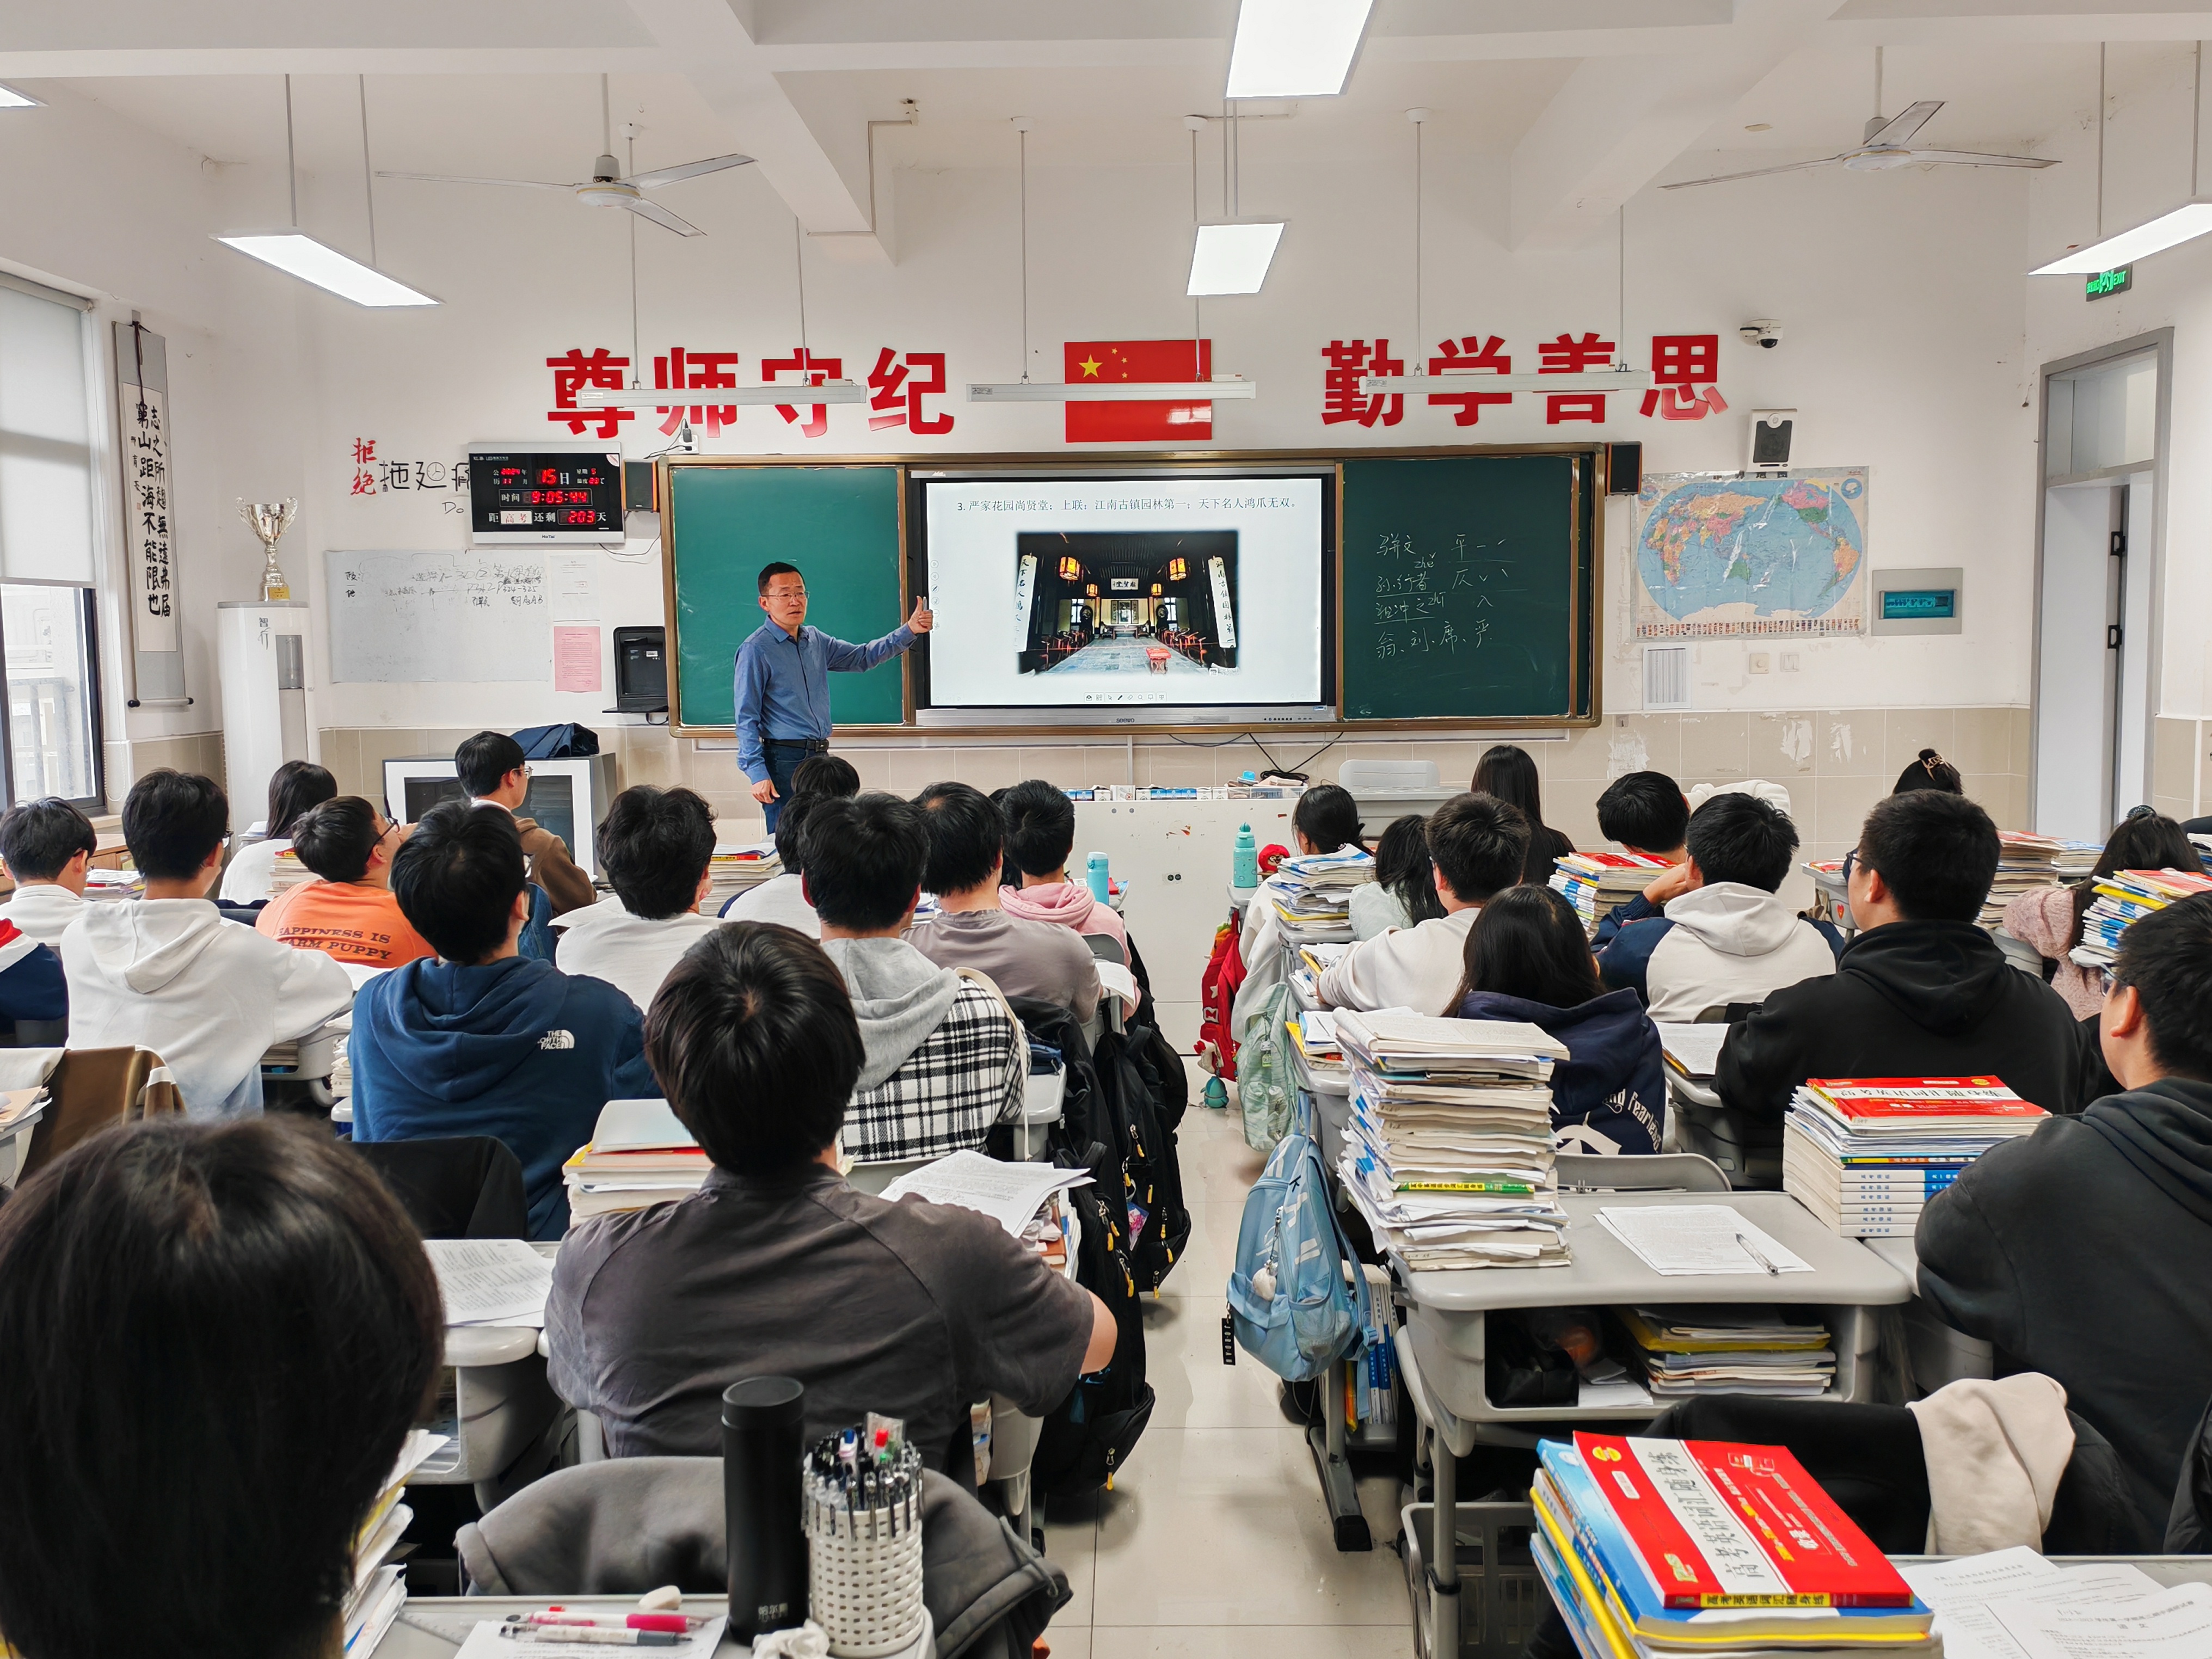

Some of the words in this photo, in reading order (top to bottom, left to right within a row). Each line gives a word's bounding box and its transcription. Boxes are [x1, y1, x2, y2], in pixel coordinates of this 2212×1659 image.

[2113, 271, 2126, 285] EXIT
[1322, 333, 1728, 428] 勤学善思
[546, 347, 954, 439] 尊师守纪
[351, 437, 377, 495] 拒绝
[542, 469, 556, 485] 15
[560, 472, 569, 484] 日
[501, 493, 520, 502] 时间
[531, 491, 587, 503] 9:05:44
[488, 513, 499, 522] 距
[534, 512, 556, 522] 还剩
[568, 511, 595, 523] 203
[597, 512, 607, 521] 天
[1375, 598, 1430, 624] 祖冲之
[282, 938, 323, 948] ARM
[327, 942, 391, 960] PUPPY
[370, 932, 391, 944] IS
[1648, 1451, 1765, 1580] 高考英语词汇随身练
